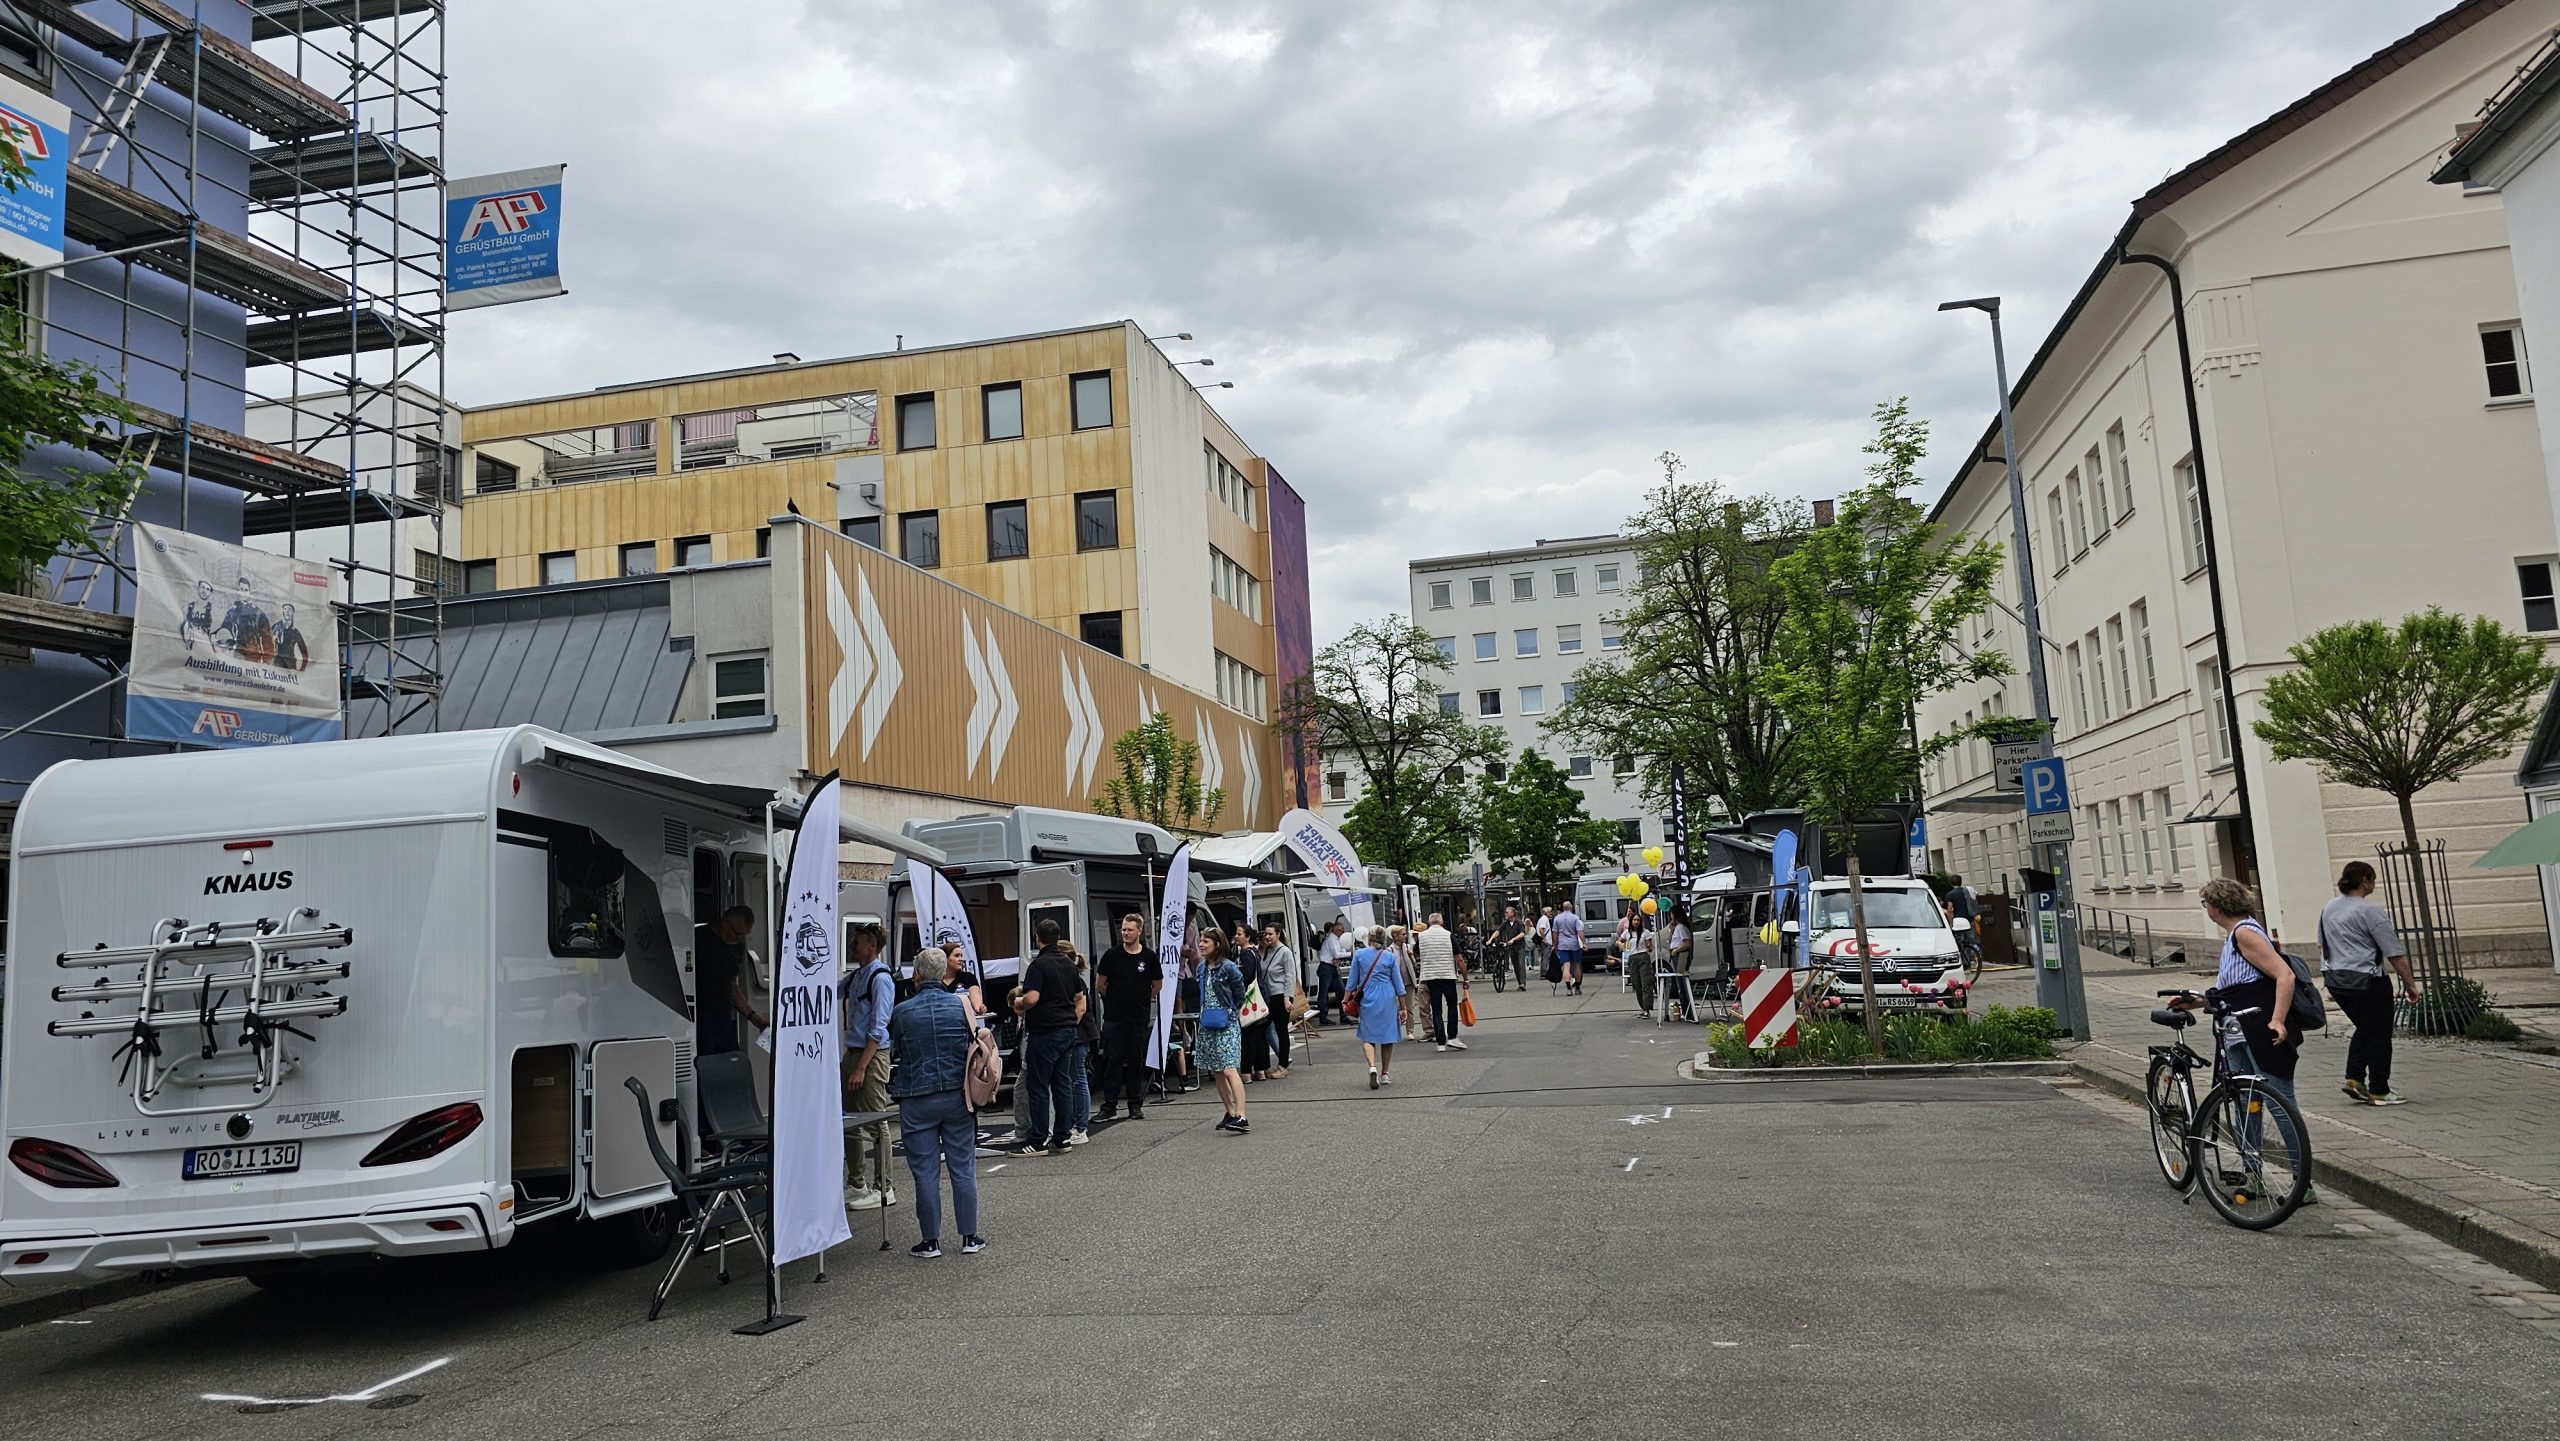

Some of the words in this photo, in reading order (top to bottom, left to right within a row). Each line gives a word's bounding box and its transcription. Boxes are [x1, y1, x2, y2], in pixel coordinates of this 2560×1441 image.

[458, 189, 548, 242] AP
[455, 233, 517, 255] GERÜSTBAU
[519, 229, 550, 243] GmbH
[184, 655, 243, 677] Ausbildung
[245, 667, 261, 678] mit
[262, 668, 299, 686] Zukunft!
[191, 708, 242, 738] AP
[233, 729, 294, 745] GERÜSTBAU
[2010, 747, 2030, 756] Hier
[2031, 766, 2056, 809] P
[2032, 828, 2071, 839] Parkschein
[2043, 819, 2056, 828] mit
[203, 870, 294, 896] KNAUS
[2039, 893, 2050, 908] P
[276, 1109, 341, 1125] PLATINUM
[302, 1117, 345, 1130] Selection
[168, 1122, 222, 1135] WAVE
[196, 1152, 221, 1172] RO
[260, 1147, 297, 1167] 130
